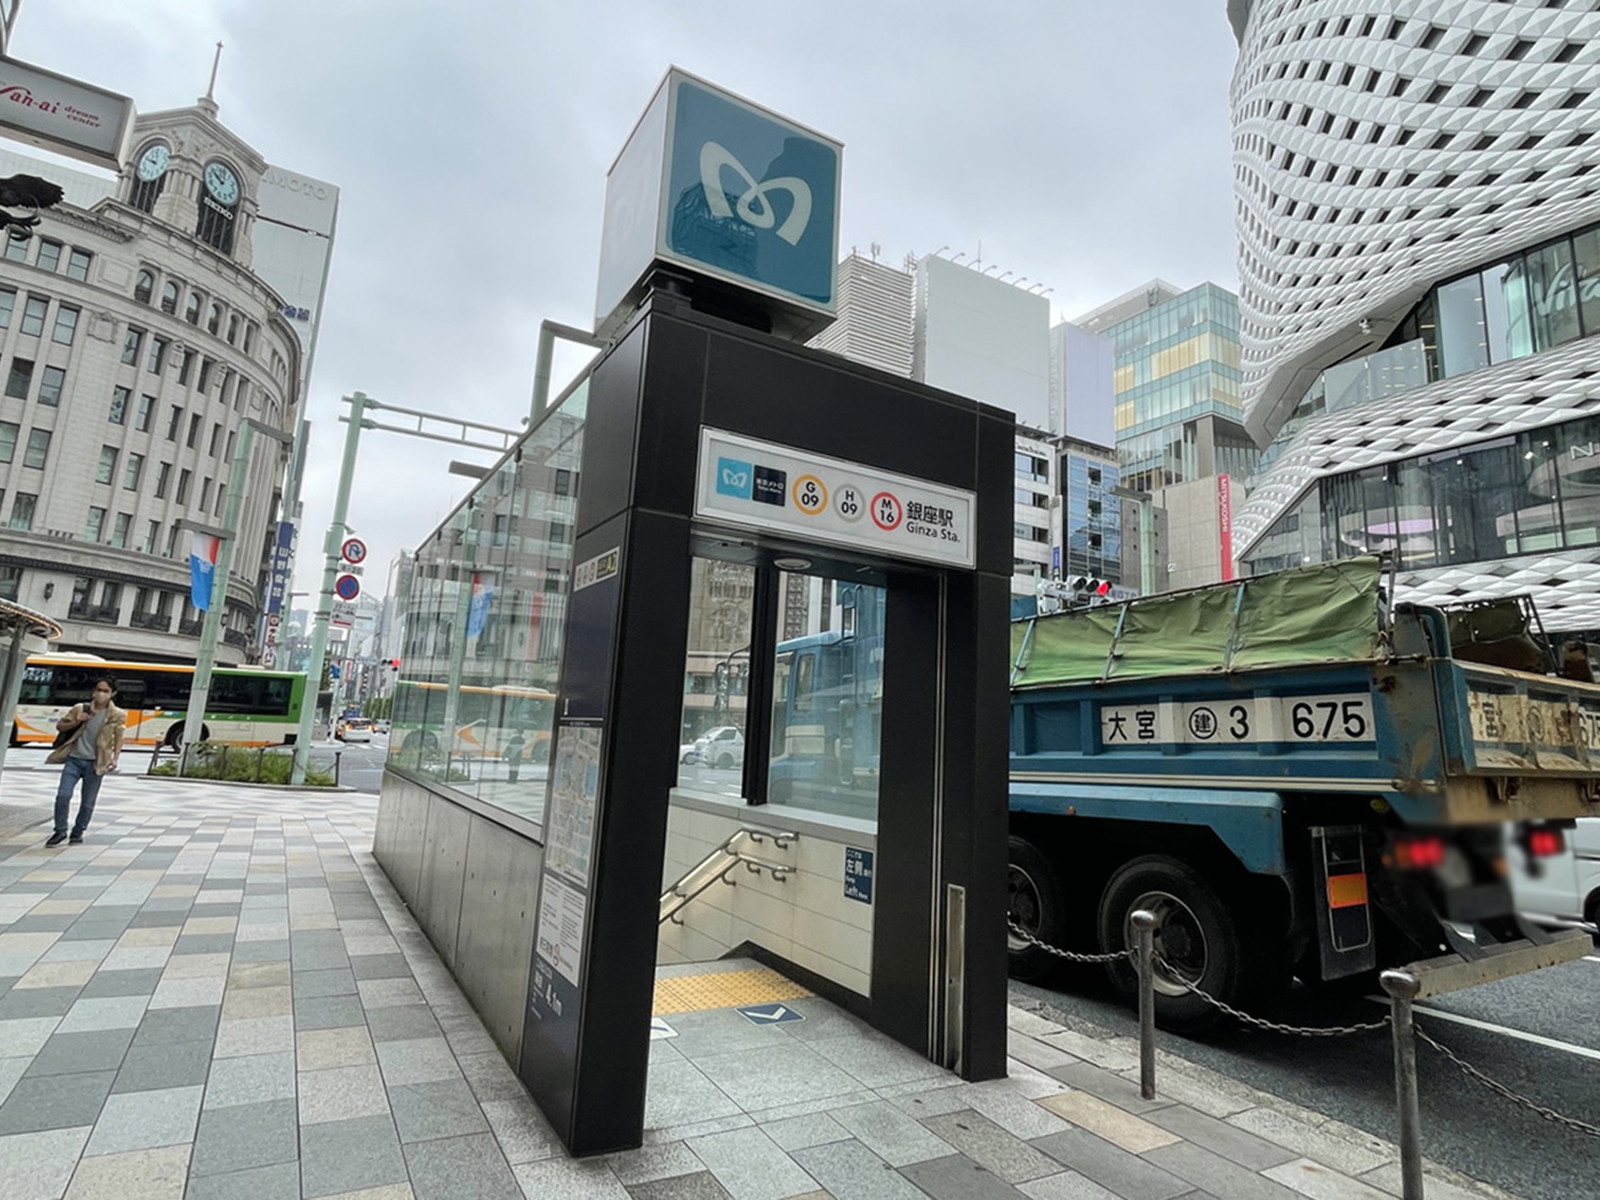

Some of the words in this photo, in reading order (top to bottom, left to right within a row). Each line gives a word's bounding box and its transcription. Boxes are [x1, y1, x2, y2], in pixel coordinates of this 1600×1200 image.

[64, 105, 99, 121] dream
[67, 114, 101, 128] center
[203, 197, 233, 220] SEIKO
[805, 481, 816, 494] G
[801, 492, 819, 508] 09
[845, 490, 854, 502] H
[881, 498, 893, 510] M
[840, 500, 858, 516] 09
[1219, 477, 1229, 533] MITSUKOSHI
[879, 509, 895, 524] 16
[906, 500, 954, 528] 銀座駅
[906, 521, 938, 539] Ginza
[940, 527, 961, 543] Sta.
[1108, 709, 1156, 741] 大宮
[1230, 705, 1250, 740] 3
[1291, 701, 1366, 740] 675
